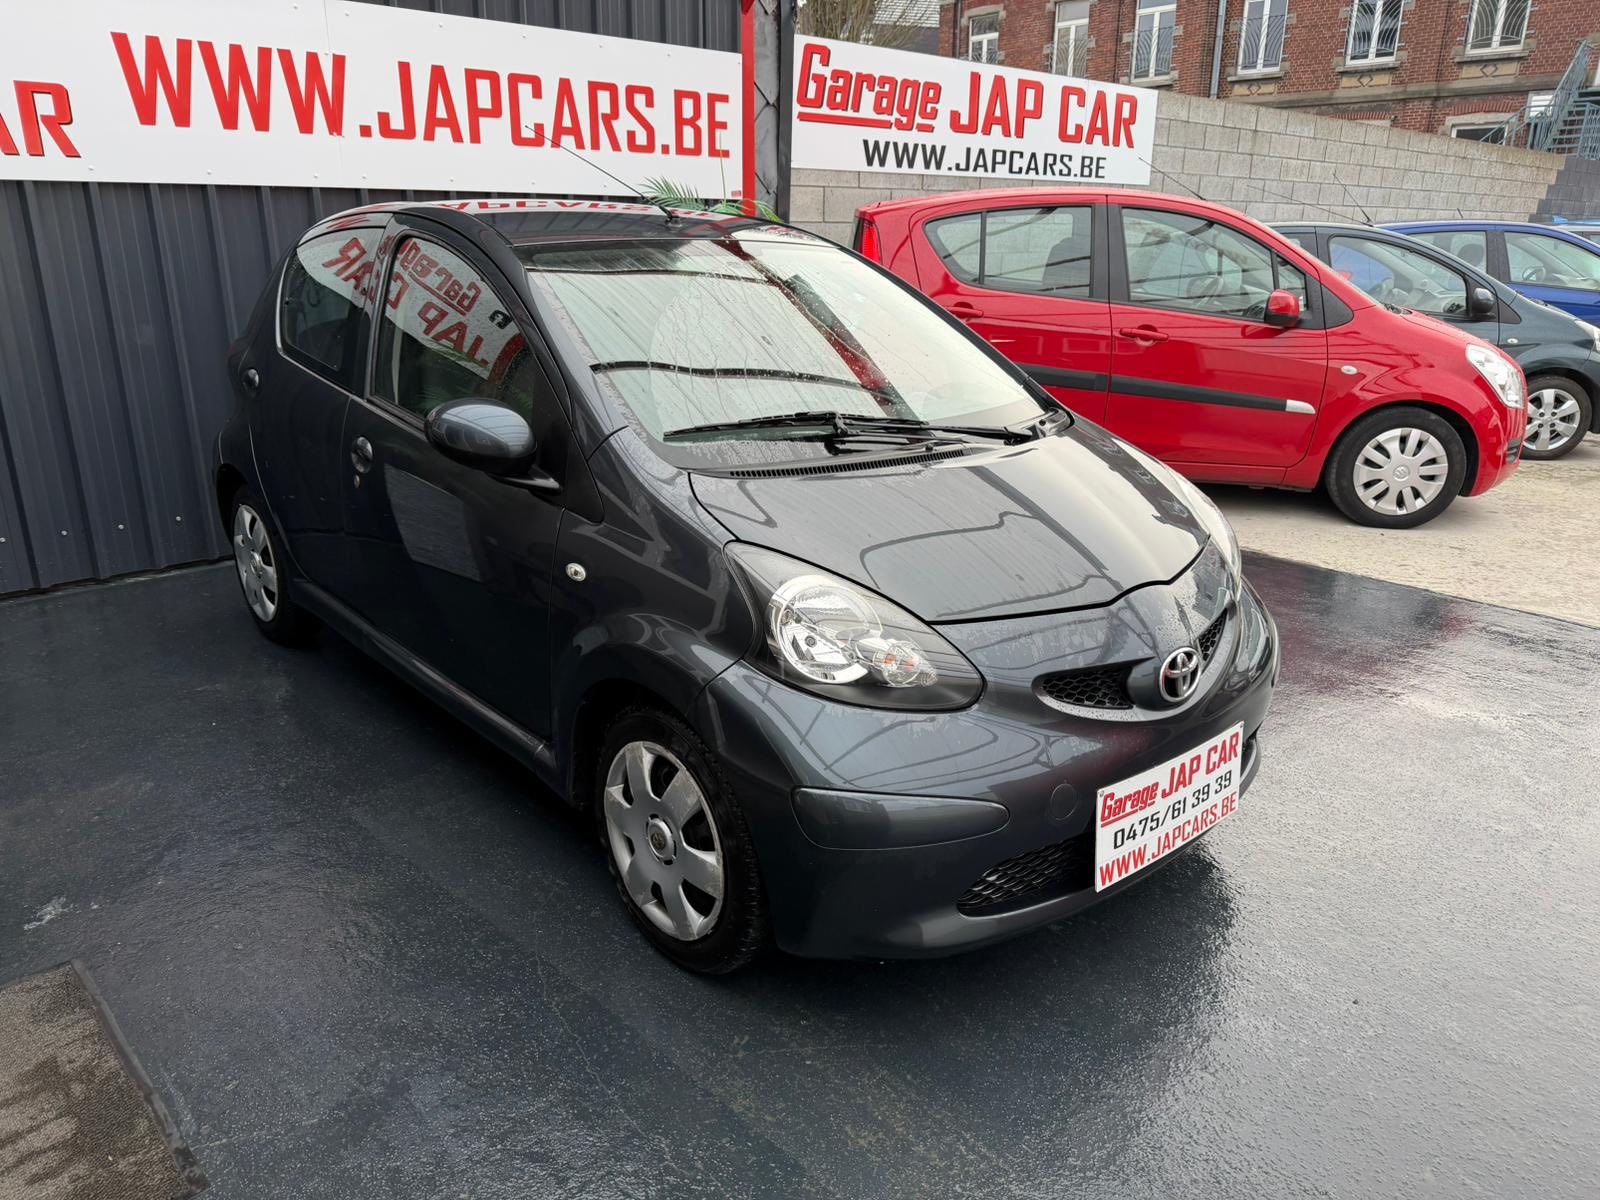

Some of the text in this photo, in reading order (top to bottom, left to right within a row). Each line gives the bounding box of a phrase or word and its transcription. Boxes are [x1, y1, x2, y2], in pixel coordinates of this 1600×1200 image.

[109, 31, 730, 158] WWW.JAPCARS.BE
[796, 43, 1138, 149] Garage JAP CAR
[862, 138, 1107, 179] WWW.JAPCARS.BE
[1100, 731, 1240, 823] Garage JAP CAR
[1113, 769, 1233, 850] 0475/61 39 39
[1099, 791, 1237, 886] WWW.JAPCARS.BE
